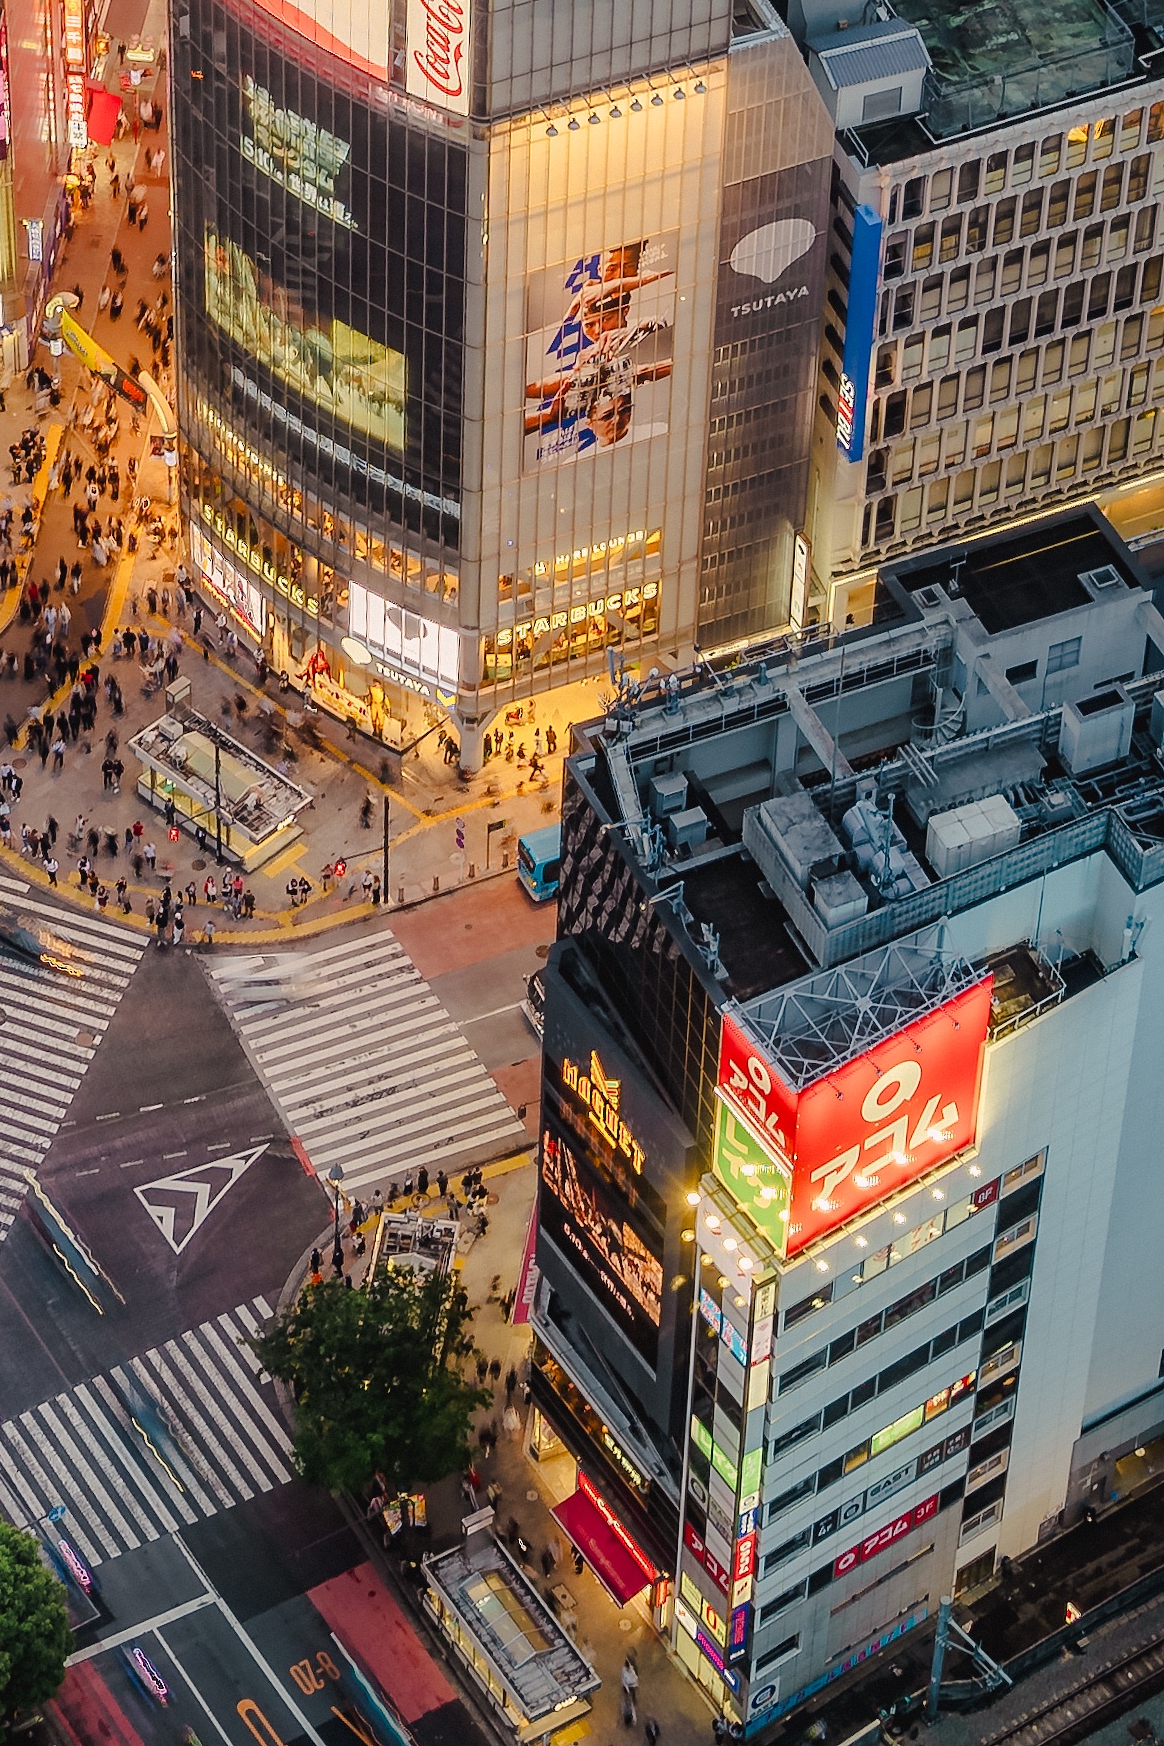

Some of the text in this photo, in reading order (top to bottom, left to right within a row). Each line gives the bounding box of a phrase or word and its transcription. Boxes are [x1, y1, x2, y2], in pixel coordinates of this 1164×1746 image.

[731, 285, 810, 318] TSUTAYA
[836, 372, 856, 450] SEIBU
[203, 503, 321, 615] STARBUCKS
[497, 582, 659, 647] STARBUCKS
[377, 662, 431, 696] TSUTAYA
[728, 1057, 787, 1148] アコム
[810, 1093, 959, 1202] アコム
[864, 1496, 935, 1553] アコム 3F
[691, 1531, 730, 1593] アコム
[289, 1650, 341, 1696] 8-20
